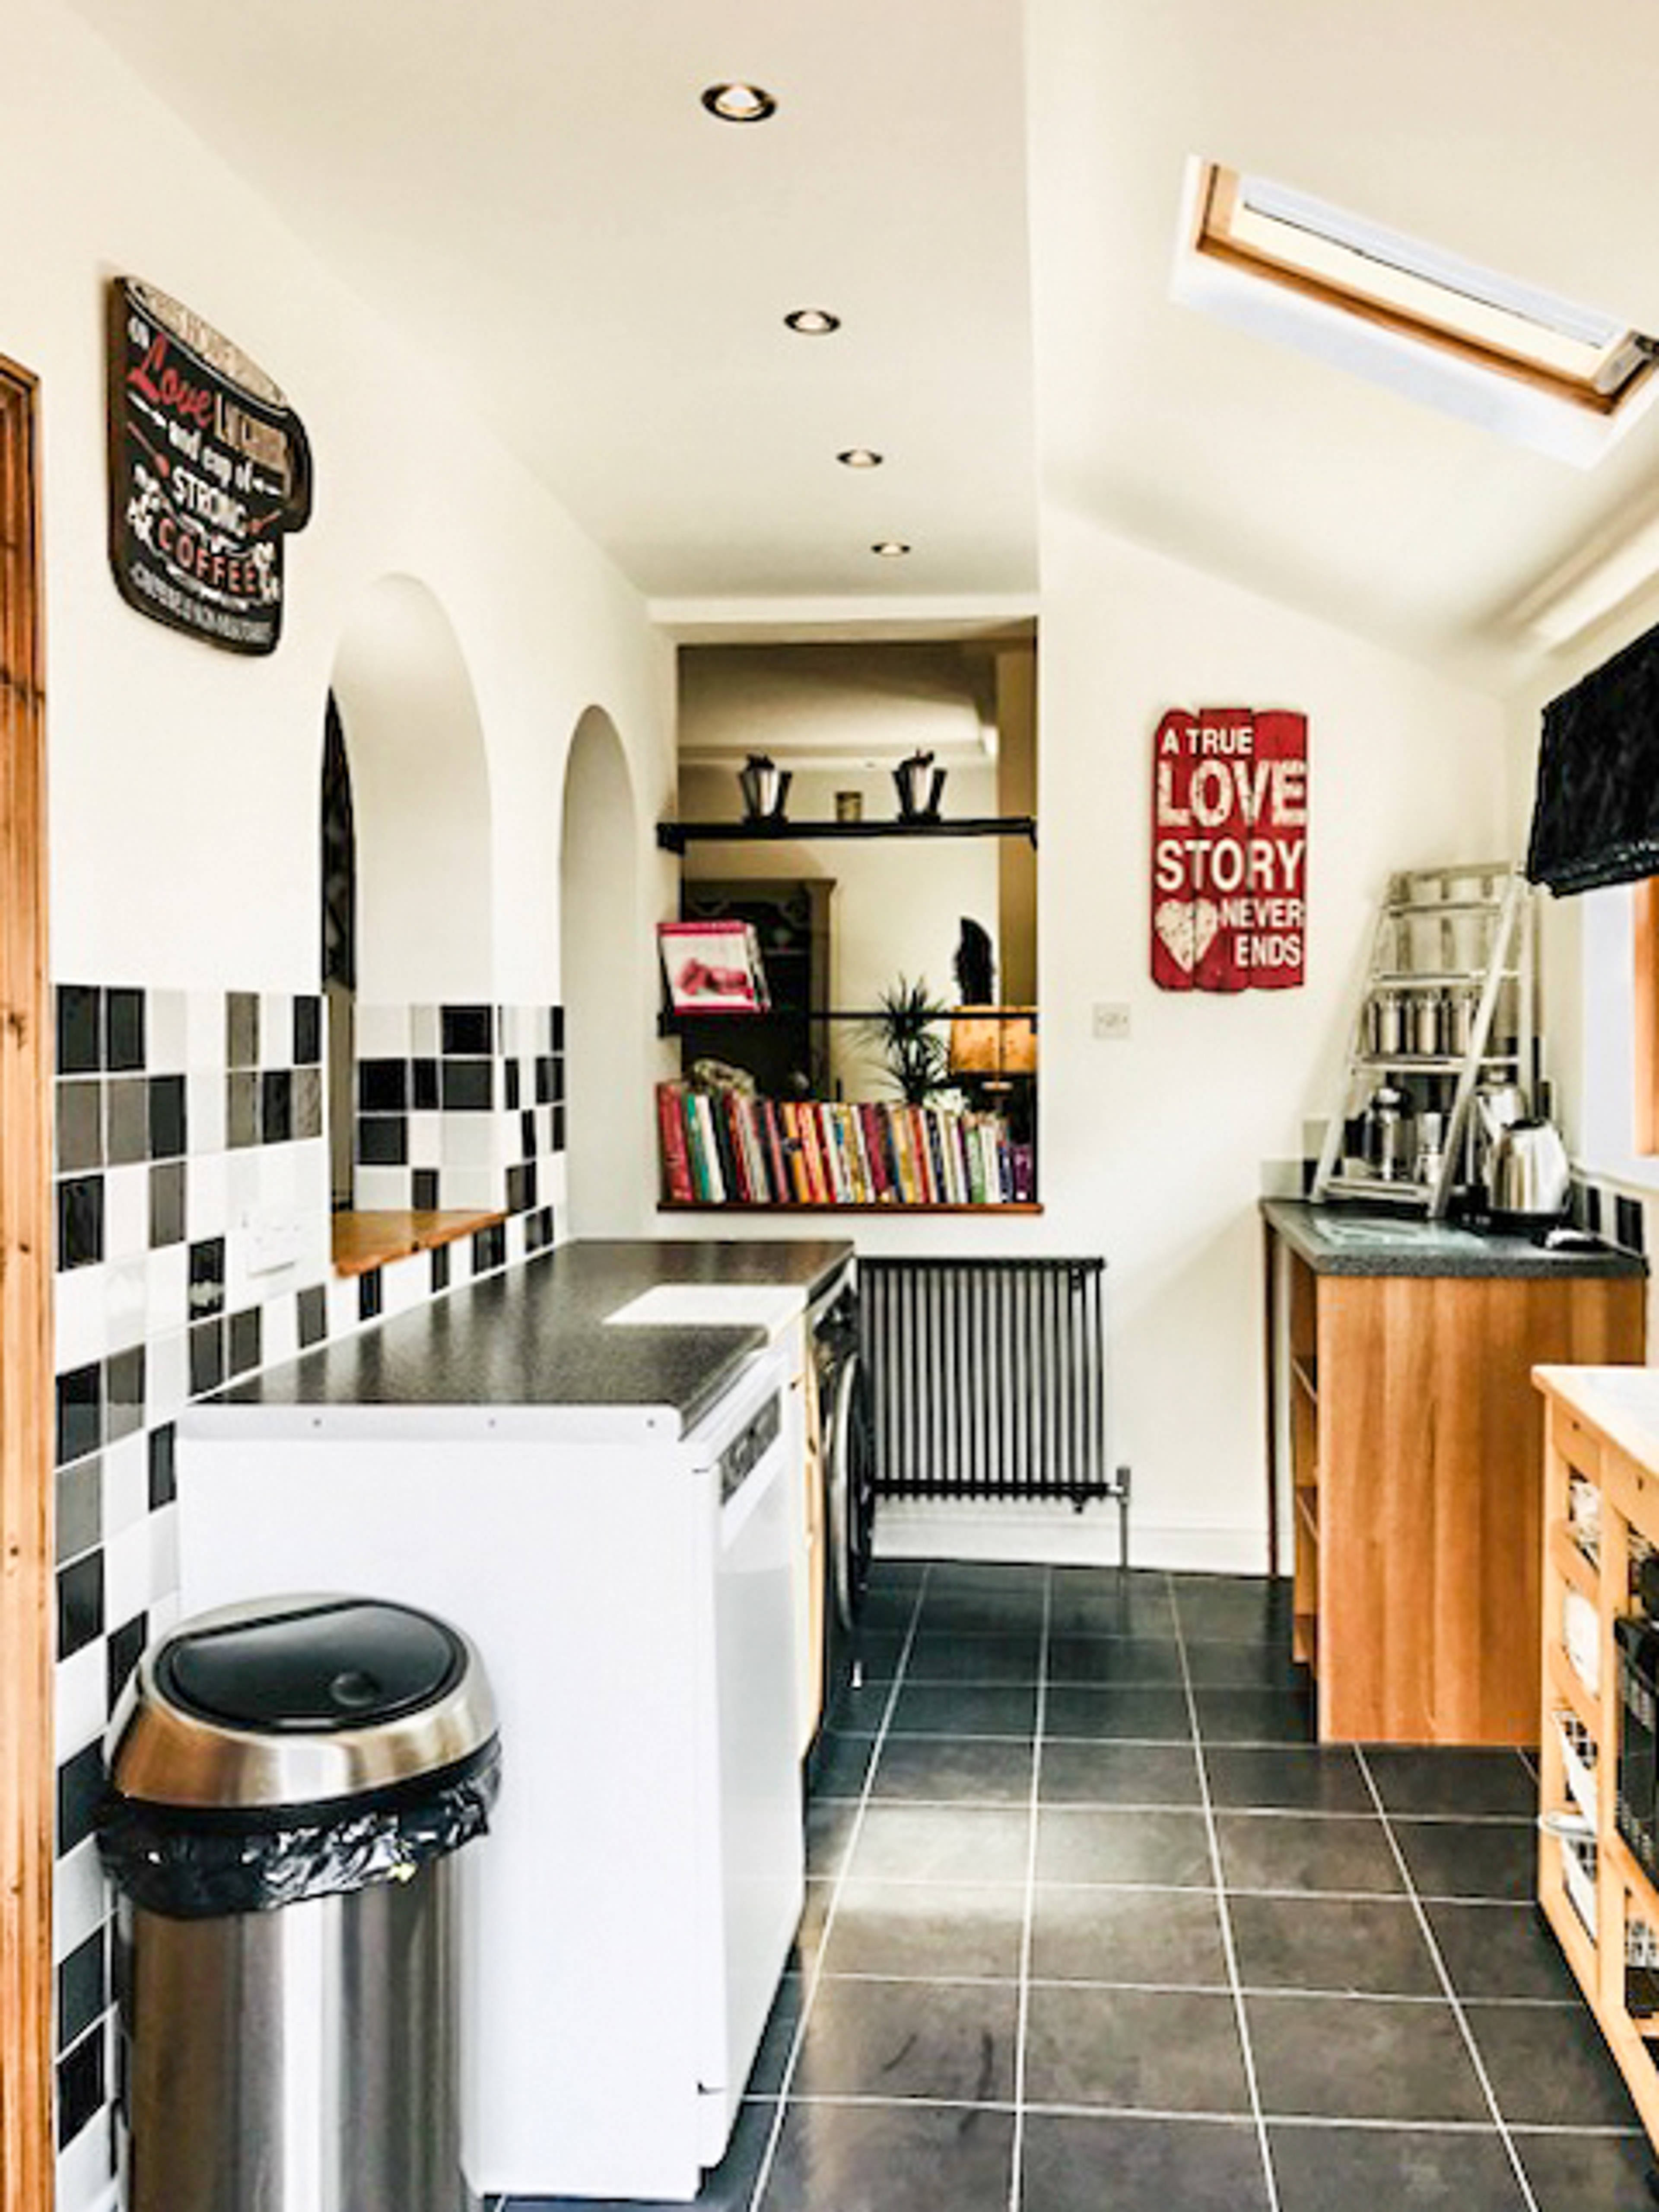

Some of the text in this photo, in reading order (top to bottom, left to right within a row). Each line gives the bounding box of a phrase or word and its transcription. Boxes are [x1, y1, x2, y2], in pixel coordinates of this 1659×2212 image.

[174, 465, 247, 538] STRONG
[158, 518, 256, 594] COFFEE
[1161, 728, 1252, 755] A TRUE
[1157, 759, 1308, 827] LOVE
[1156, 839, 1305, 890] STORY
[1220, 897, 1303, 928] NEVER
[1236, 934, 1301, 968] ENDS
